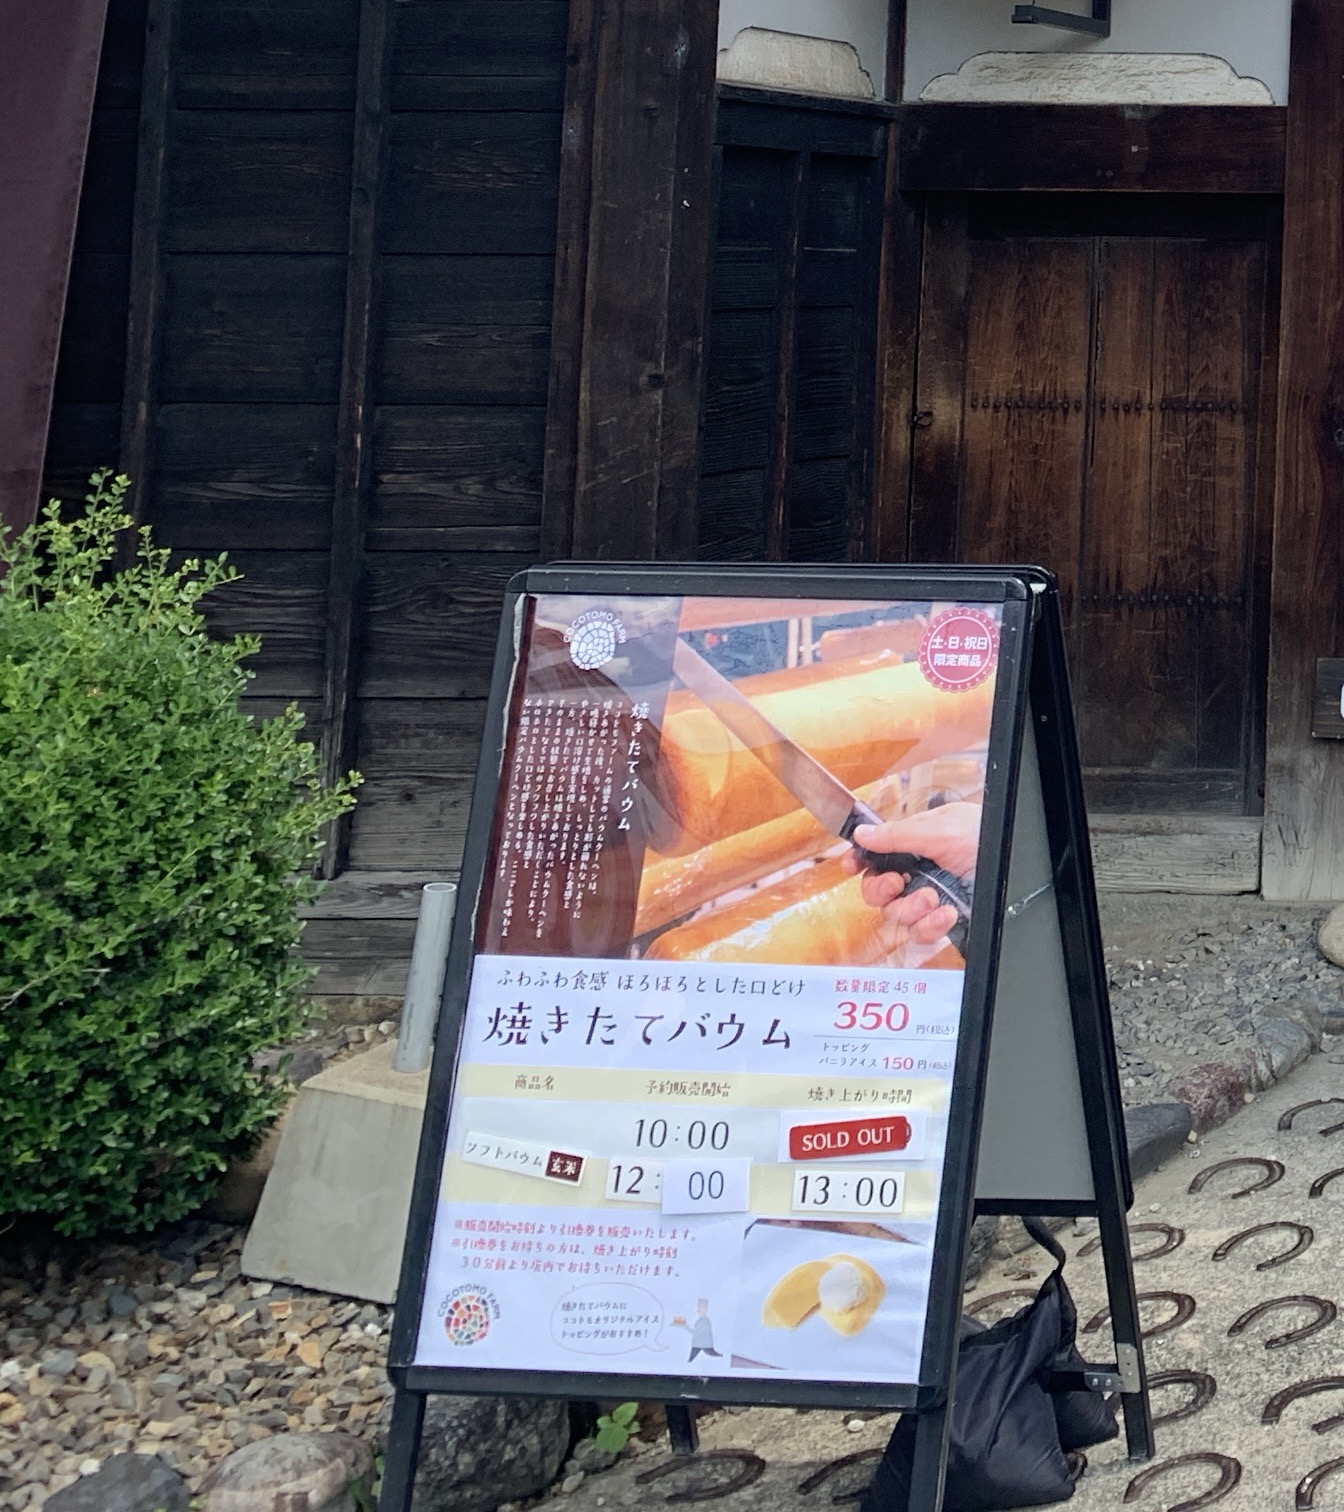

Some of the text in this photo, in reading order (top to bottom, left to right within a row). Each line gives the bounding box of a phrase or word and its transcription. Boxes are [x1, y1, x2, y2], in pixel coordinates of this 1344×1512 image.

[563, 610, 627, 644] COCOTOMO FARM
[931, 635, 988, 650] 土・日・祝日
[933, 653, 981, 667] 限定商品
[618, 701, 651, 831] 焼きたてバウム
[496, 968, 807, 996] ふわふわ食感 ほろほろとした口どけ
[482, 1002, 792, 1052] 焼きたてバウム
[833, 1001, 910, 1032] 350
[823, 1042, 871, 1053] トッピング
[818, 1056, 877, 1068] バニラアイス
[882, 1056, 914, 1071] 150
[514, 1074, 555, 1092] 商品名
[645, 1080, 731, 1099] 予約販売開始
[807, 1086, 913, 1104] 焼き上がり時間
[634, 1116, 730, 1152] 10:00
[801, 1124, 896, 1152] SOLD OUT
[464, 1139, 577, 1176] ソフトバウム 玄米
[797, 1174, 899, 1208] 13:00
[437, 1283, 502, 1320] COCOTOMO FARM
